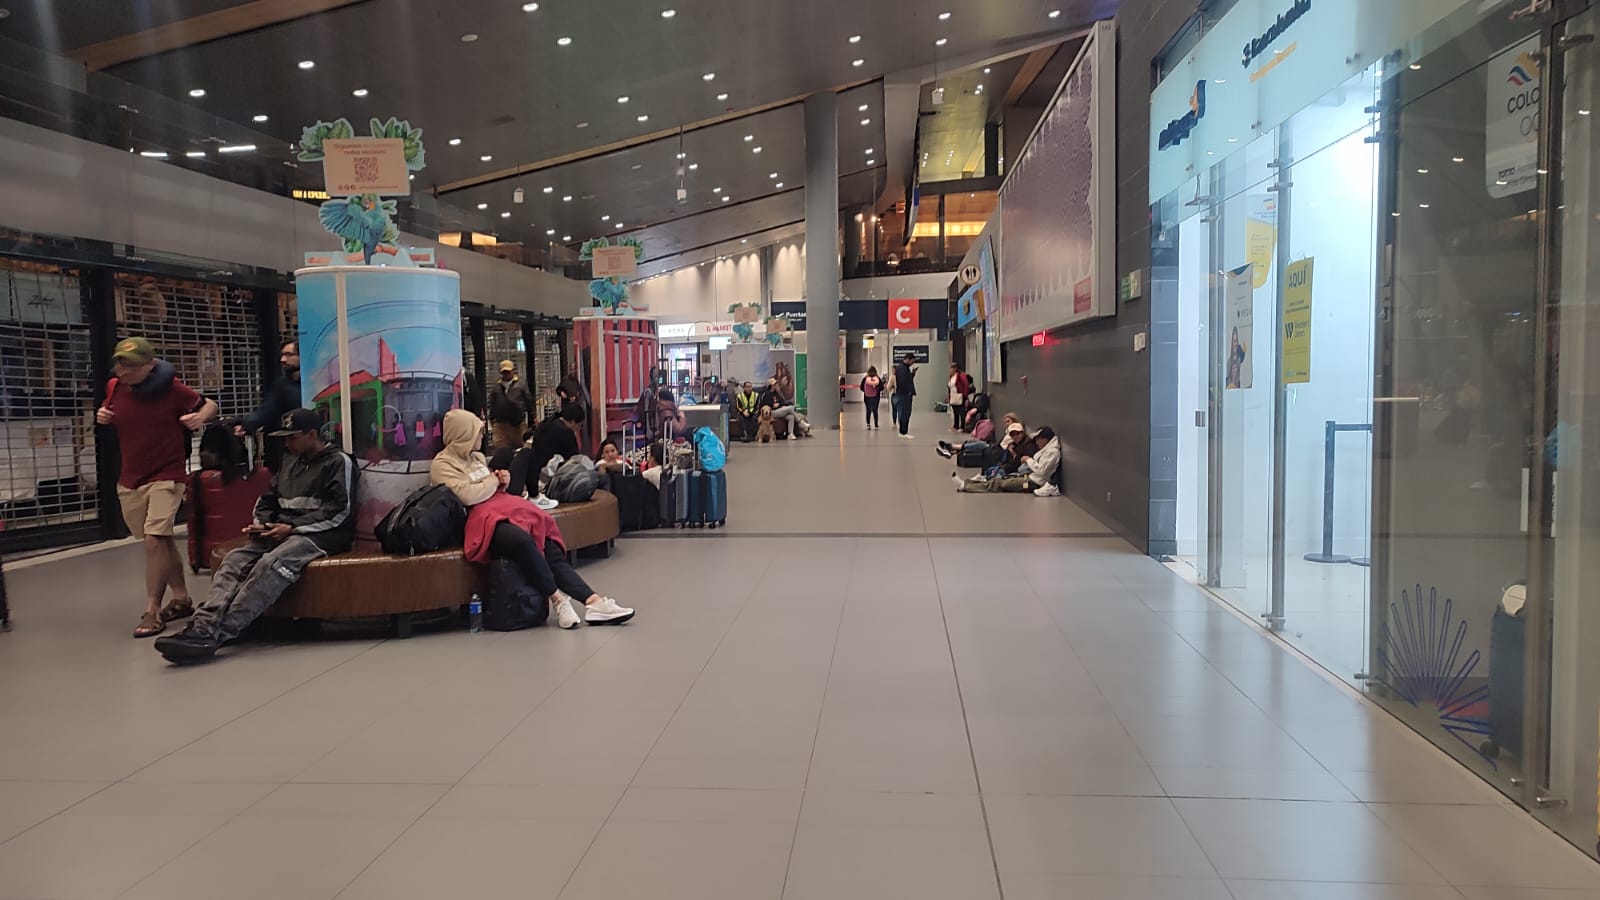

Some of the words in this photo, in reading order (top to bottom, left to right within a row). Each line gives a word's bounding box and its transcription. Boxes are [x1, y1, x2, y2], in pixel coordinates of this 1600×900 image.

[1507, 87, 1540, 114] COLO
[1288, 266, 1307, 289] AQUÍ
[895, 305, 911, 324] C
